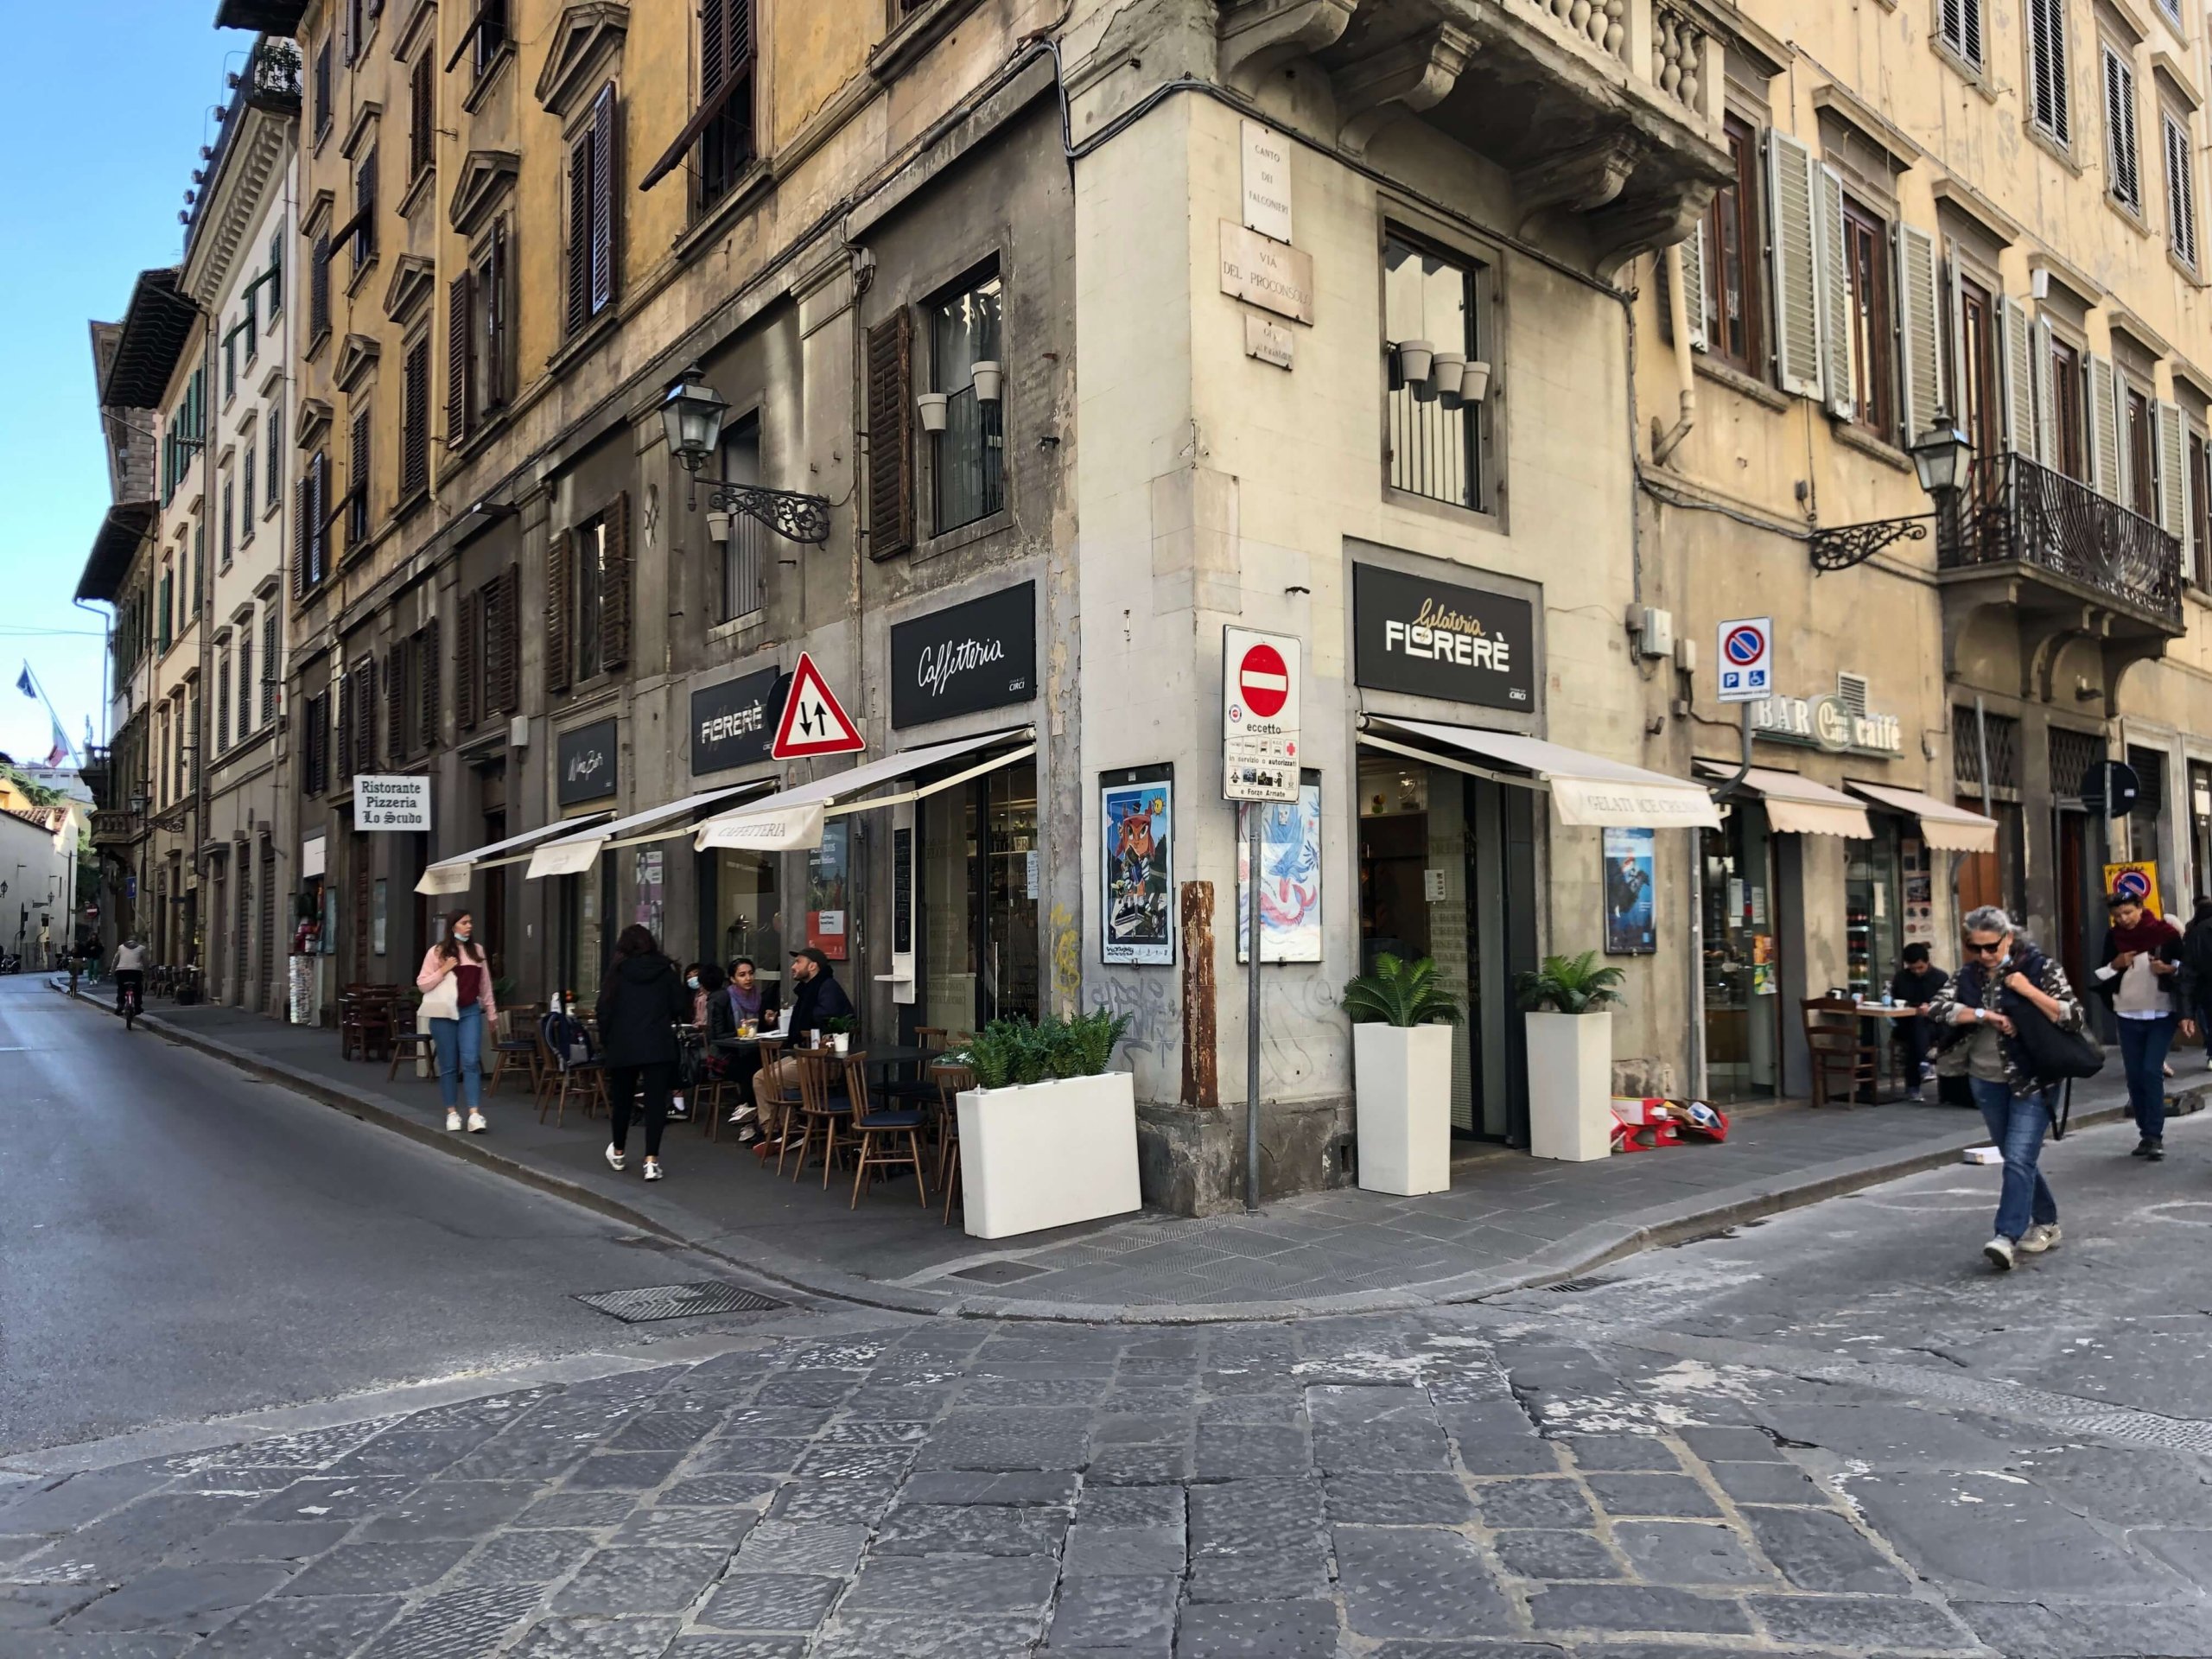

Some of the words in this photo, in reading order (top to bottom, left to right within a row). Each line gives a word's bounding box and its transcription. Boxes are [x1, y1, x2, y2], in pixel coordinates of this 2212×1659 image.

[1255, 144, 1281, 163] CANTO
[1261, 171, 1273, 184] DEI
[1249, 190, 1289, 215] FALCONIERI
[1259, 251, 1277, 269] VIA
[1224, 261, 1243, 280] DEL
[1250, 271, 1313, 306] PROCONSOLO
[1412, 597, 1486, 641] Gelateria
[918, 638, 1005, 696] Caffetteria
[1758, 695, 1811, 734] BAR
[1247, 722, 1281, 734] eccetto
[1237, 755, 1260, 764] servizio
[1268, 759, 1297, 767] autorizzati
[361, 780, 421, 794] Ristorante
[1266, 789, 1286, 798] Armate
[365, 796, 417, 808] Pizzeria
[1586, 794, 1635, 812] GELATI
[1636, 798, 1660, 813] ICE
[362, 810, 380, 823] Lo
[384, 811, 422, 823] Scudo
[717, 823, 786, 837] CAFFETTERIA
